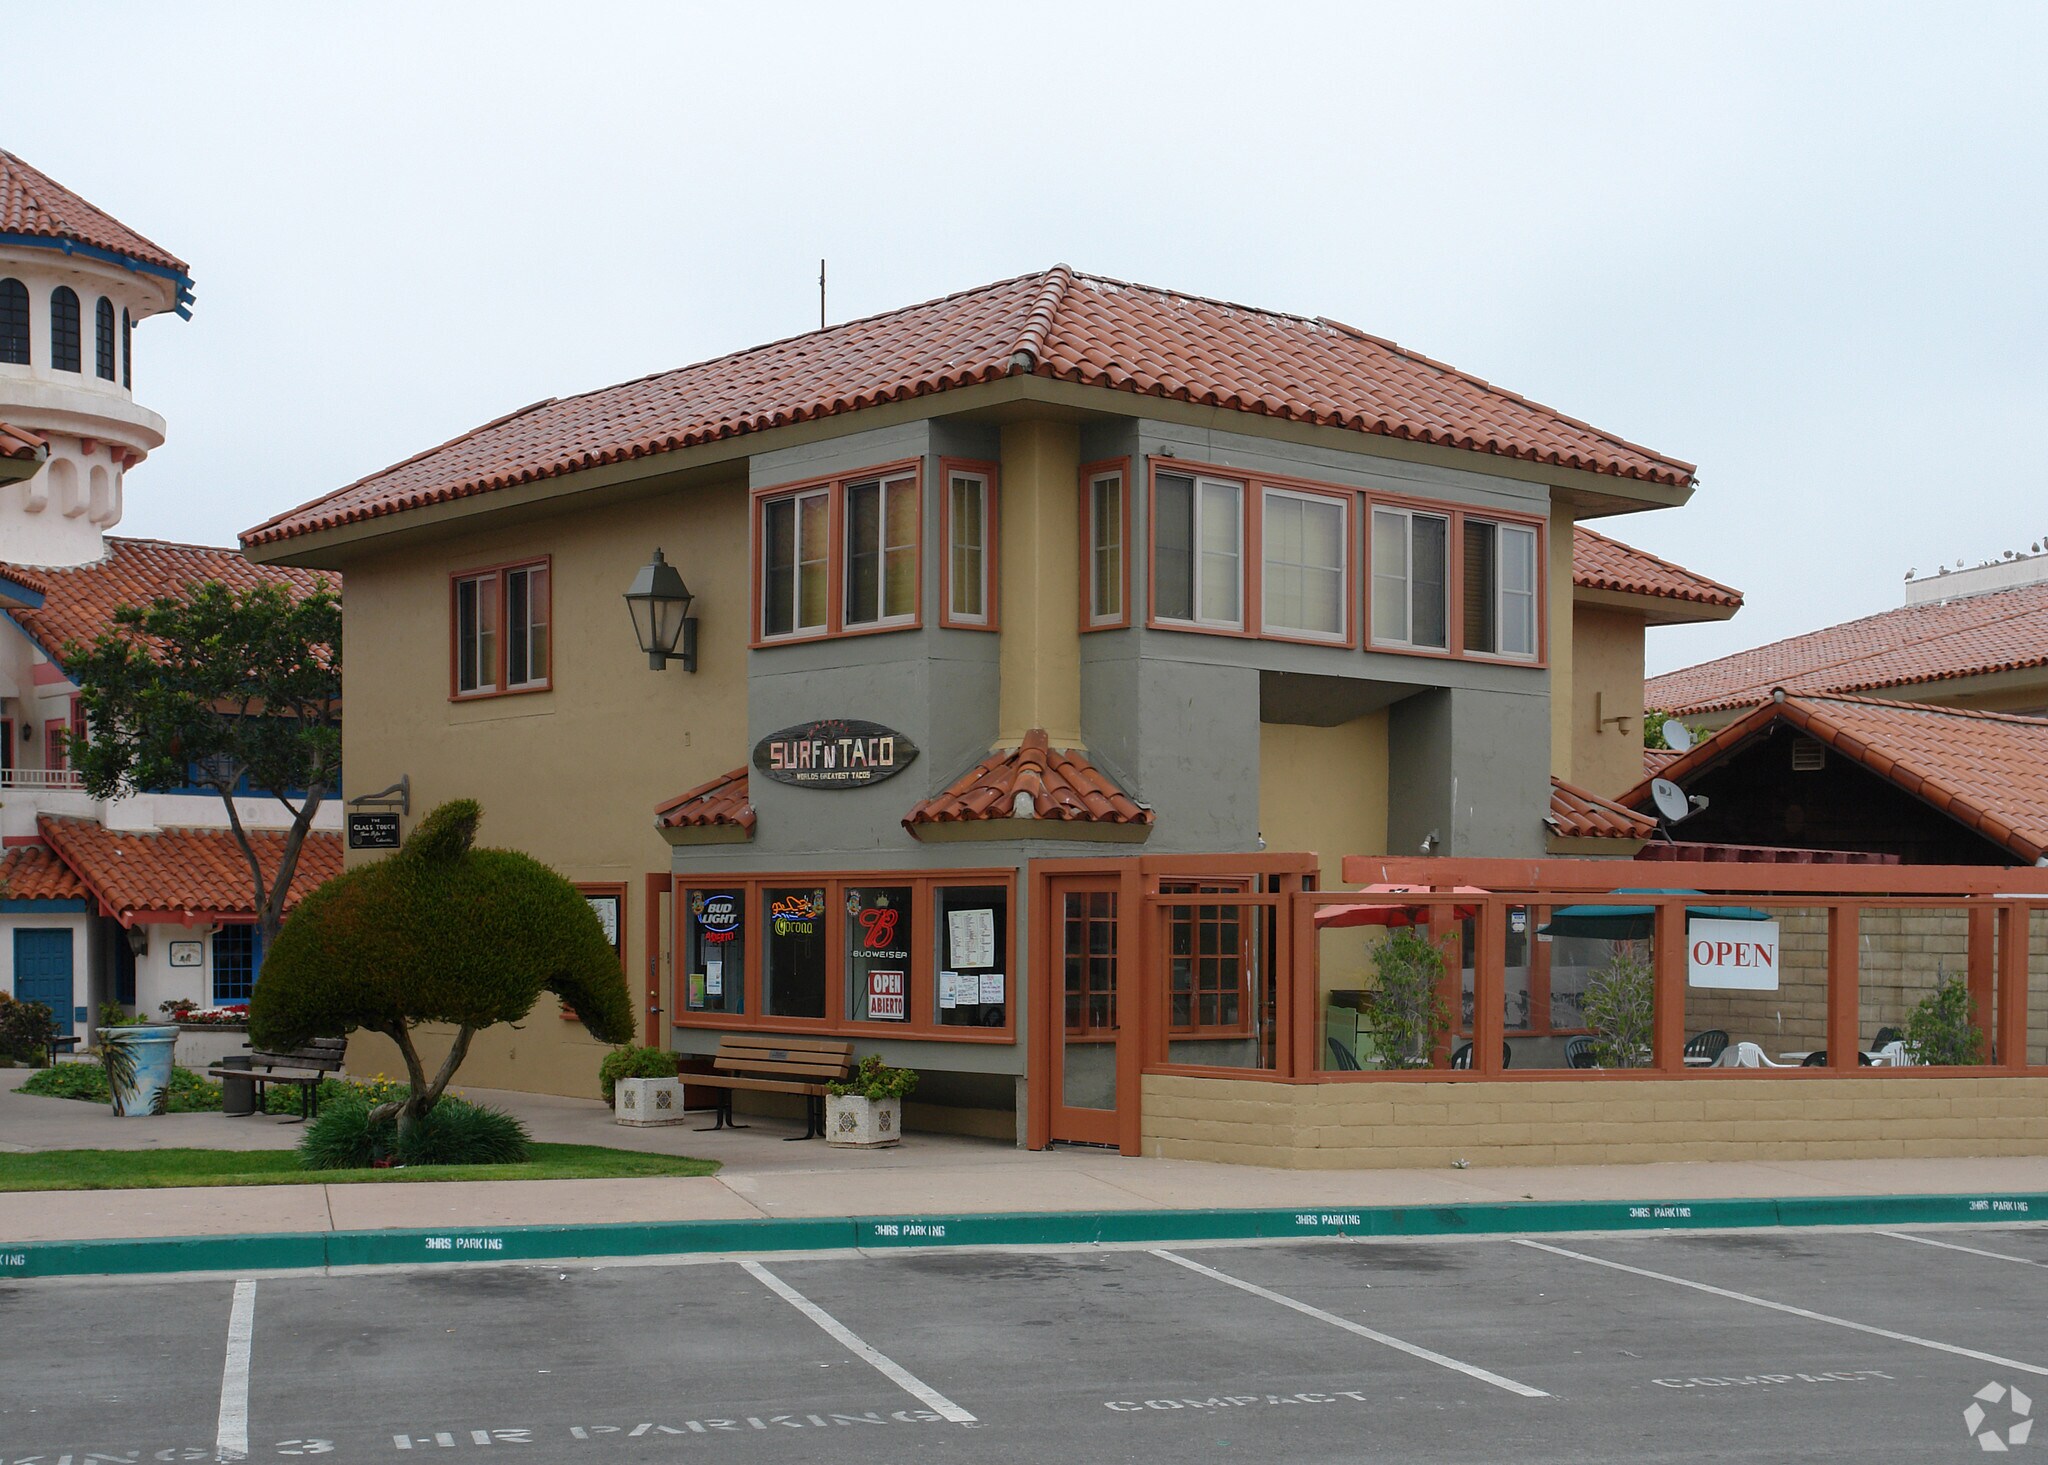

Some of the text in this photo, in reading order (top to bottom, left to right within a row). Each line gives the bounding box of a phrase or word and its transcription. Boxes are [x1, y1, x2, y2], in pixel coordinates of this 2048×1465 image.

[770, 740, 822, 770] SURF
[838, 737, 894, 768] TACO
[851, 771, 871, 779] TACOS
[707, 903, 733, 913] BUD
[702, 914, 737, 924] LIGHT
[775, 917, 813, 936] Corona
[852, 950, 908, 959] BUDWEISER
[1692, 940, 1774, 968] OPEN
[873, 974, 901, 993] OPEN
[871, 997, 903, 1014] ABIERTO
[1629, 1207, 1691, 1218] 3HRS PARKING
[1968, 1200, 2029, 1212] 3HRS PARKING
[1295, 1214, 1360, 1225] 3HRS PARKING
[874, 1224, 946, 1237] 3HRS PARKING
[425, 1237, 503, 1250] 3HRS PARKING
[1651, 1370, 1896, 1388] COMPACT
[1103, 1390, 1368, 1412] COMPACT
[275, 1410, 944, 1455] 3 HR PARKING
